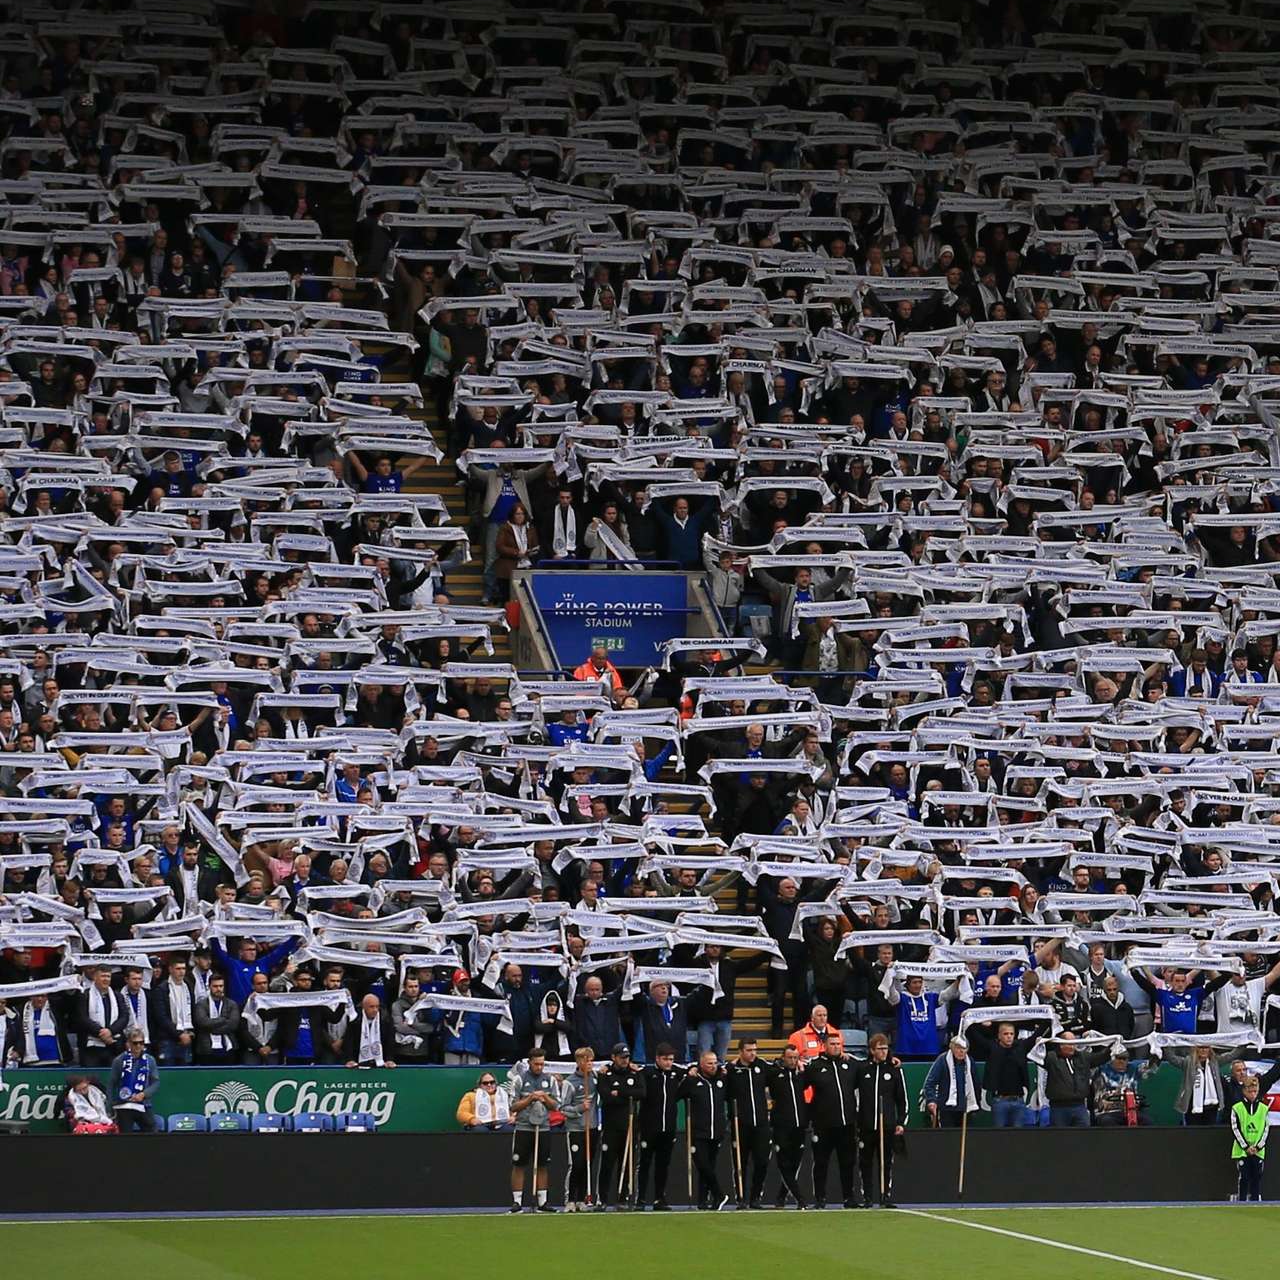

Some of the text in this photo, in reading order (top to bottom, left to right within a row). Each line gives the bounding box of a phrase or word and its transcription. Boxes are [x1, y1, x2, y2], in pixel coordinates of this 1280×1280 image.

[38, 478, 79, 486] CHAIRMAN
[555, 601, 663, 616] KING POWER
[585, 618, 633, 628] STADIUM
[1048, 883, 1067, 891] KING
[92, 954, 136, 962] CHAIRMAN
[1024, 1007, 1049, 1015] POSSIBLE
[911, 1015, 929, 1023] POWER
[265, 1079, 396, 1126] Chang
[361, 1081, 387, 1089] BEER
